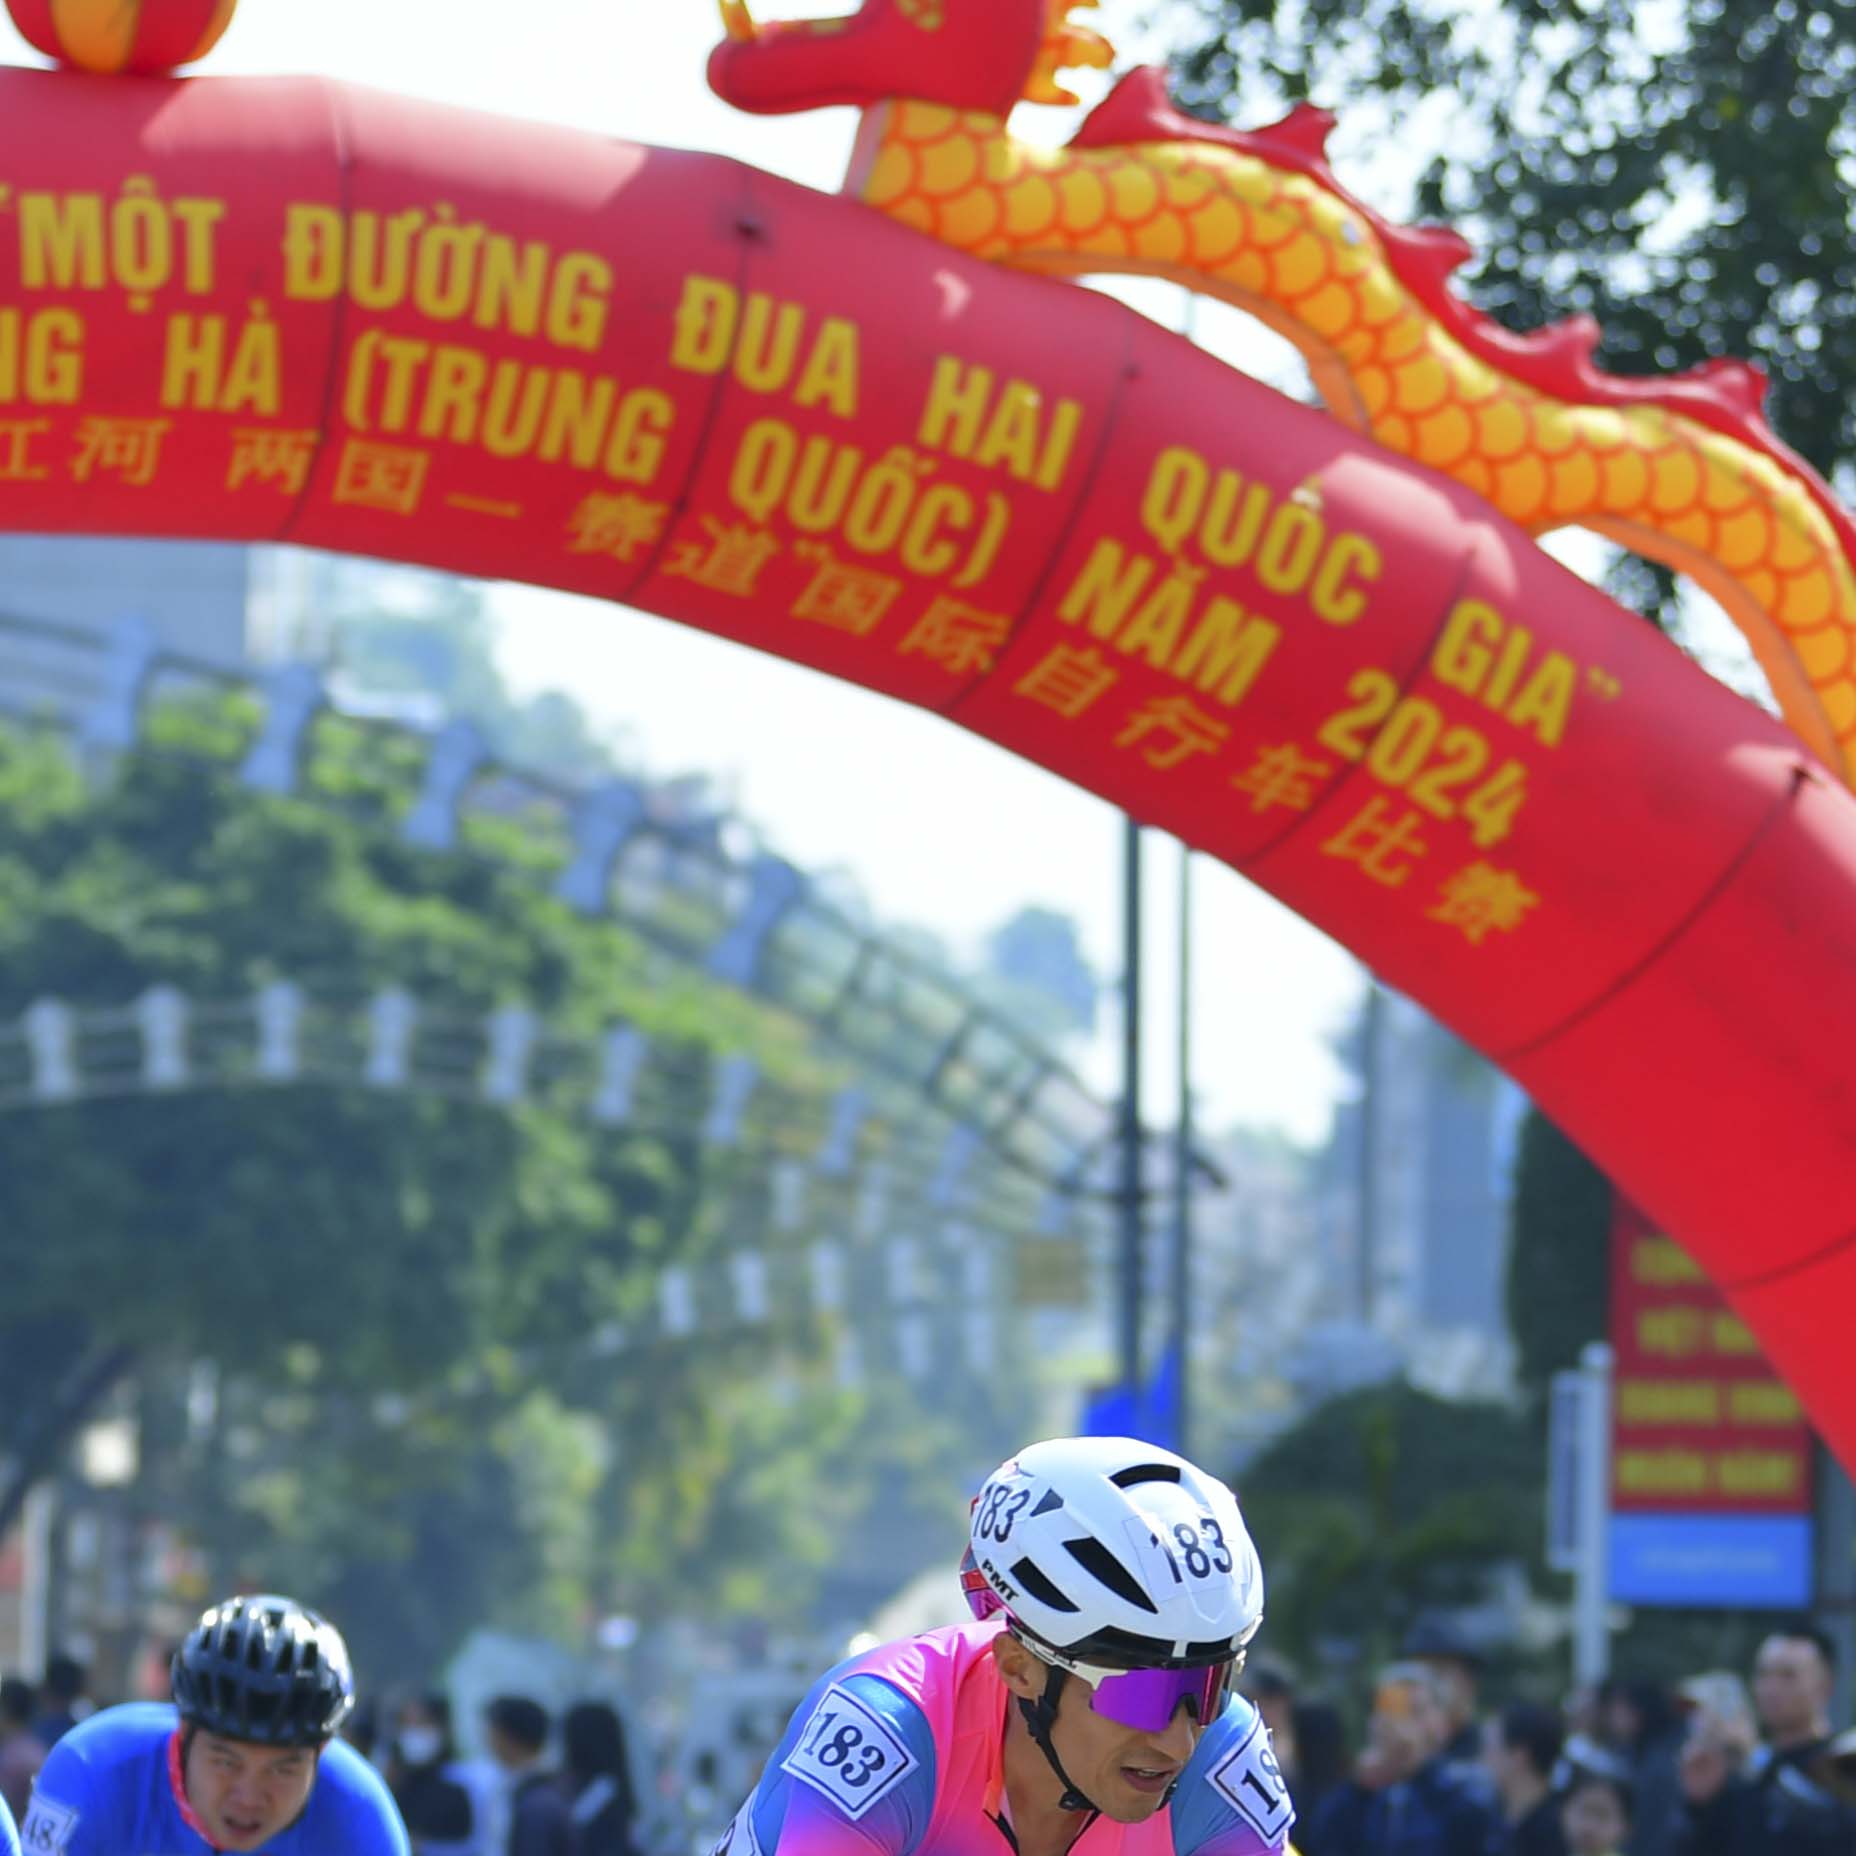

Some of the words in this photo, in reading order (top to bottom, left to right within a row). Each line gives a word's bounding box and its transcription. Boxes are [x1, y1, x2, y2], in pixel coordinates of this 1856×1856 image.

[284, 198, 614, 353] ĐƯỜNG
[671, 274, 862, 416] ĐUA
[921, 356, 1084, 491] HAI
[1143, 446, 1384, 626] QUỐC
[341, 328, 675, 487] (TRUNG
[730, 417, 1009, 589] QUỐC)
[1058, 537, 1282, 705] NĂM
[1318, 672, 1534, 847] 2024
[973, 1482, 1030, 1542] 183
[980, 1558, 1019, 1602] PMT
[1147, 1517, 1243, 1584] 183
[803, 1711, 886, 1788] 183
